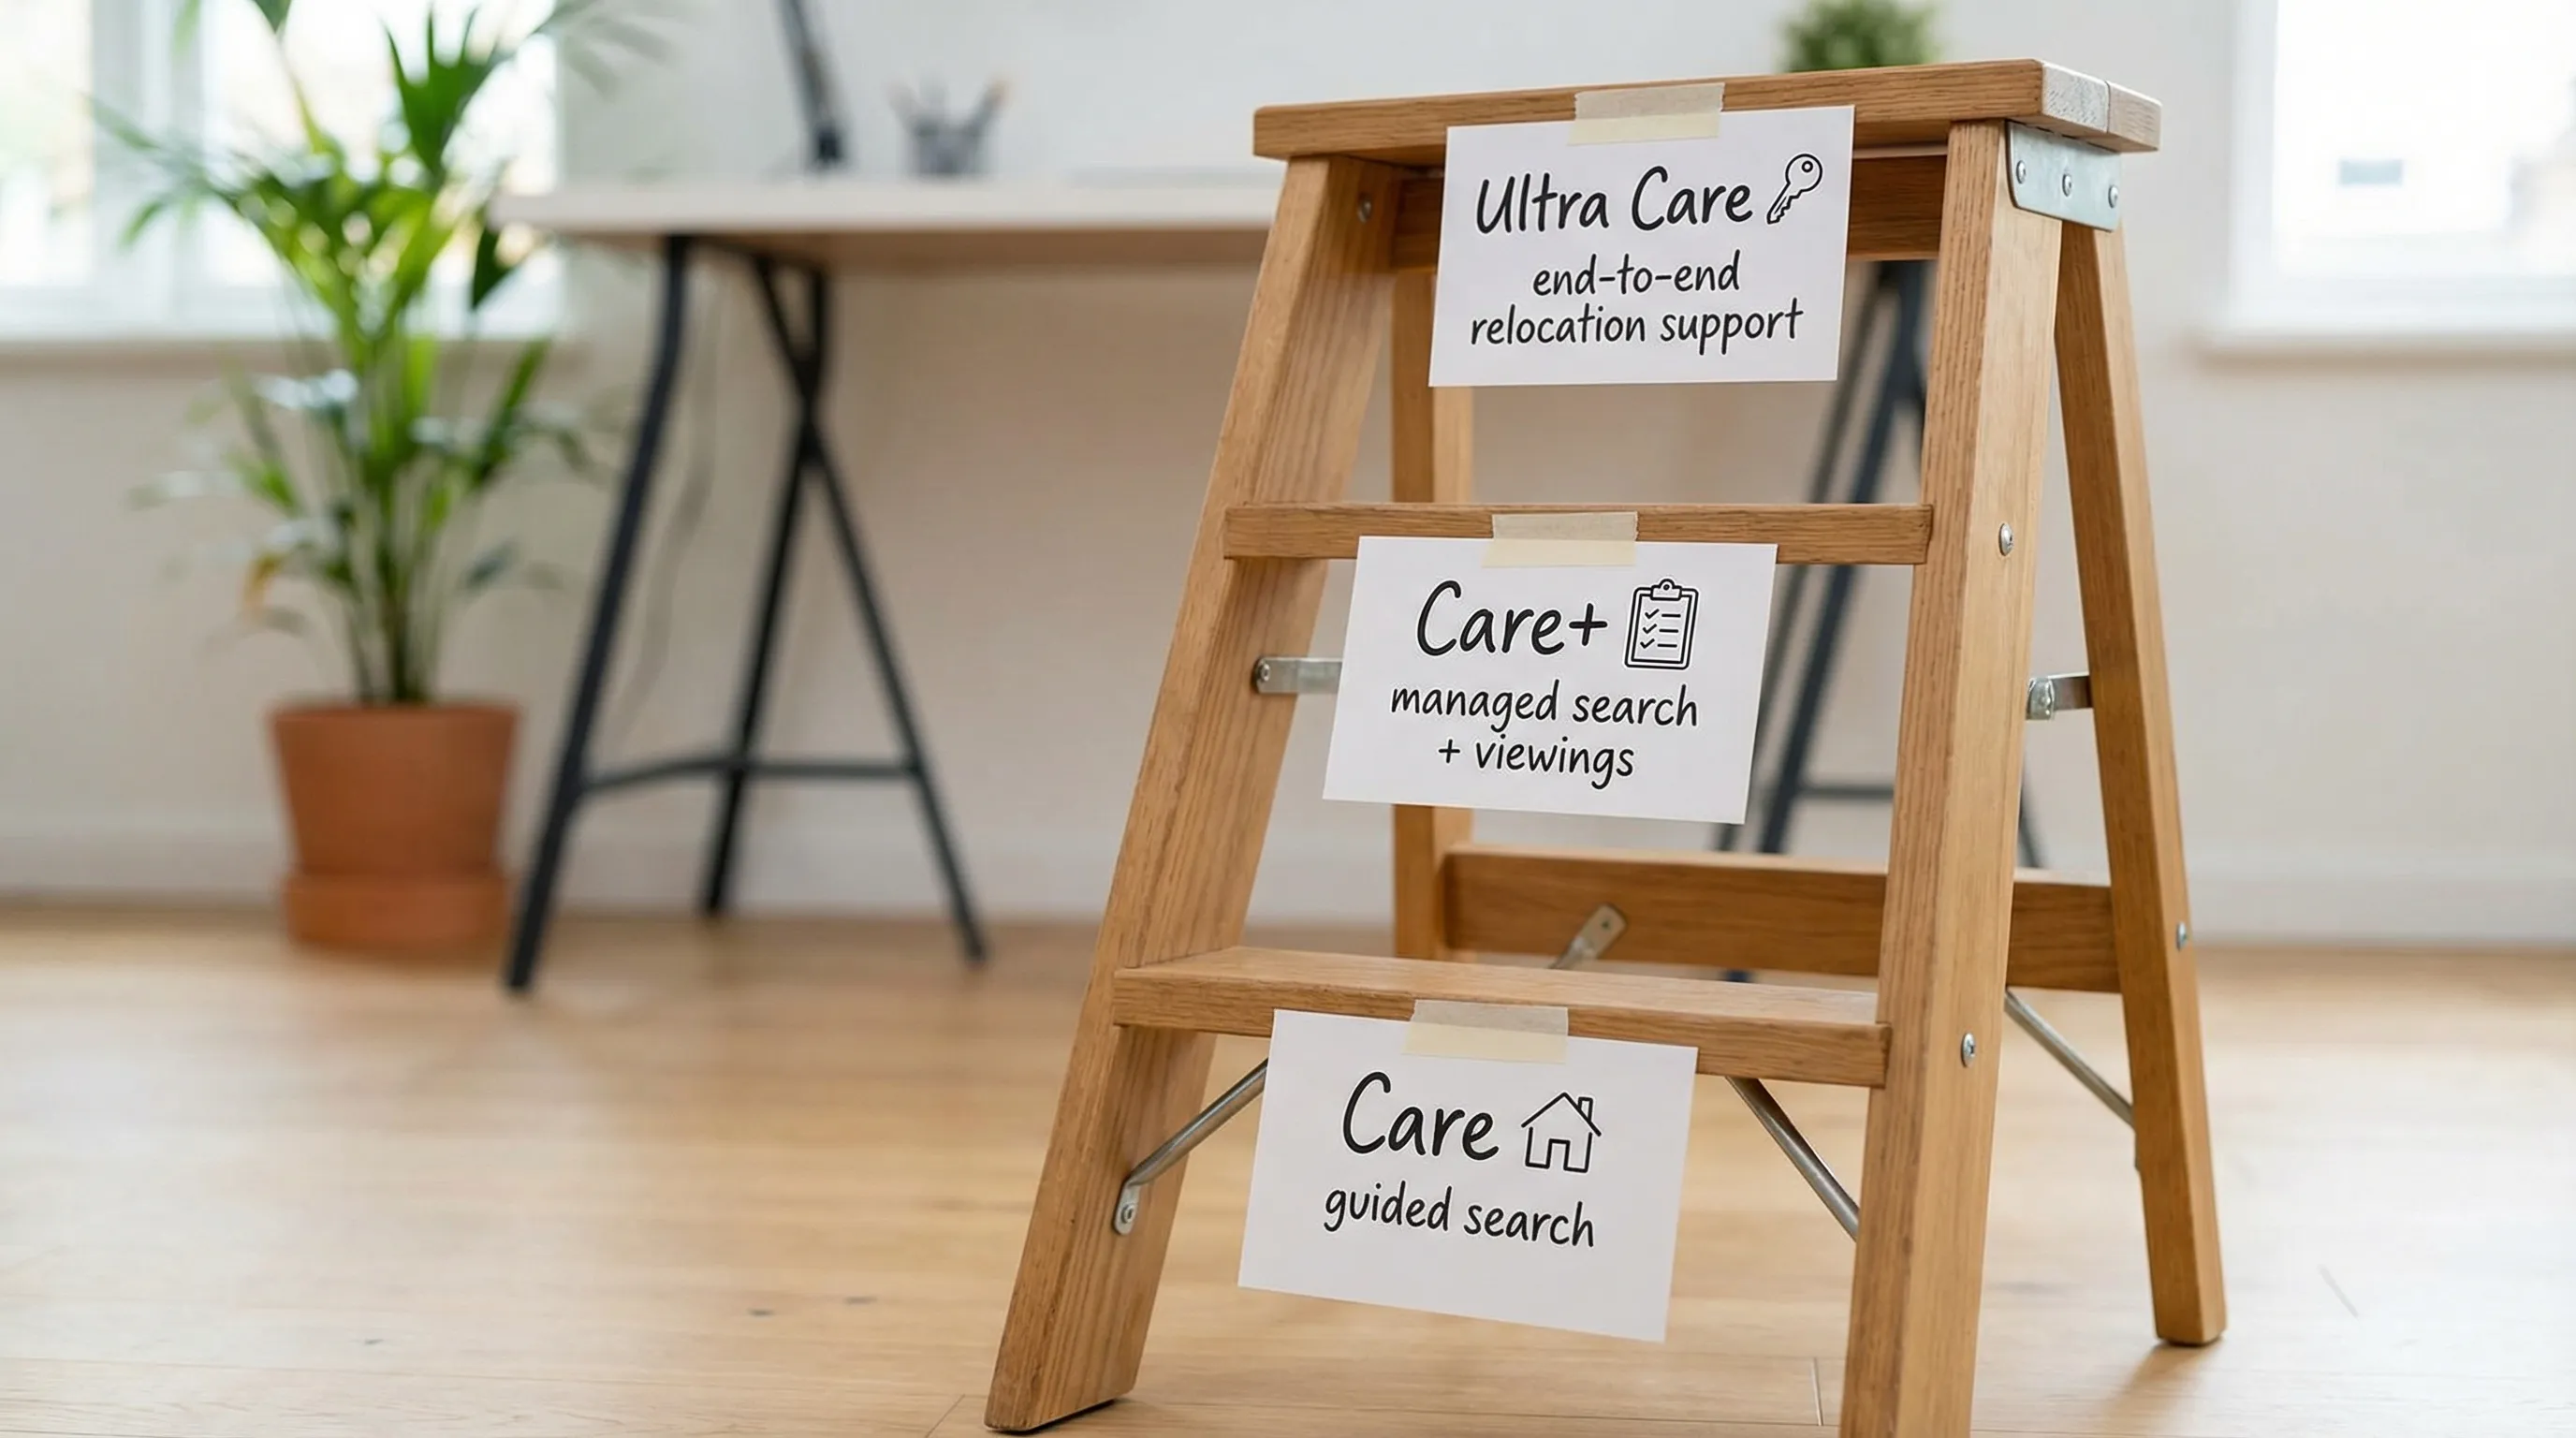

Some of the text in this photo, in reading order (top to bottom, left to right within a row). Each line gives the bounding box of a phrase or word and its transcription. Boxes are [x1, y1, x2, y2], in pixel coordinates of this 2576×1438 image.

[1476, 166, 1753, 234] Ultra Care
[1532, 249, 1741, 297] end-to-end
[1471, 297, 1804, 356] relocation support
[1416, 580, 1608, 656] Care+
[1391, 679, 1697, 733] managed search
[1438, 733, 1634, 790] + viewings
[1342, 1071, 1500, 1161] Care
[1324, 1180, 1594, 1248] guided search
